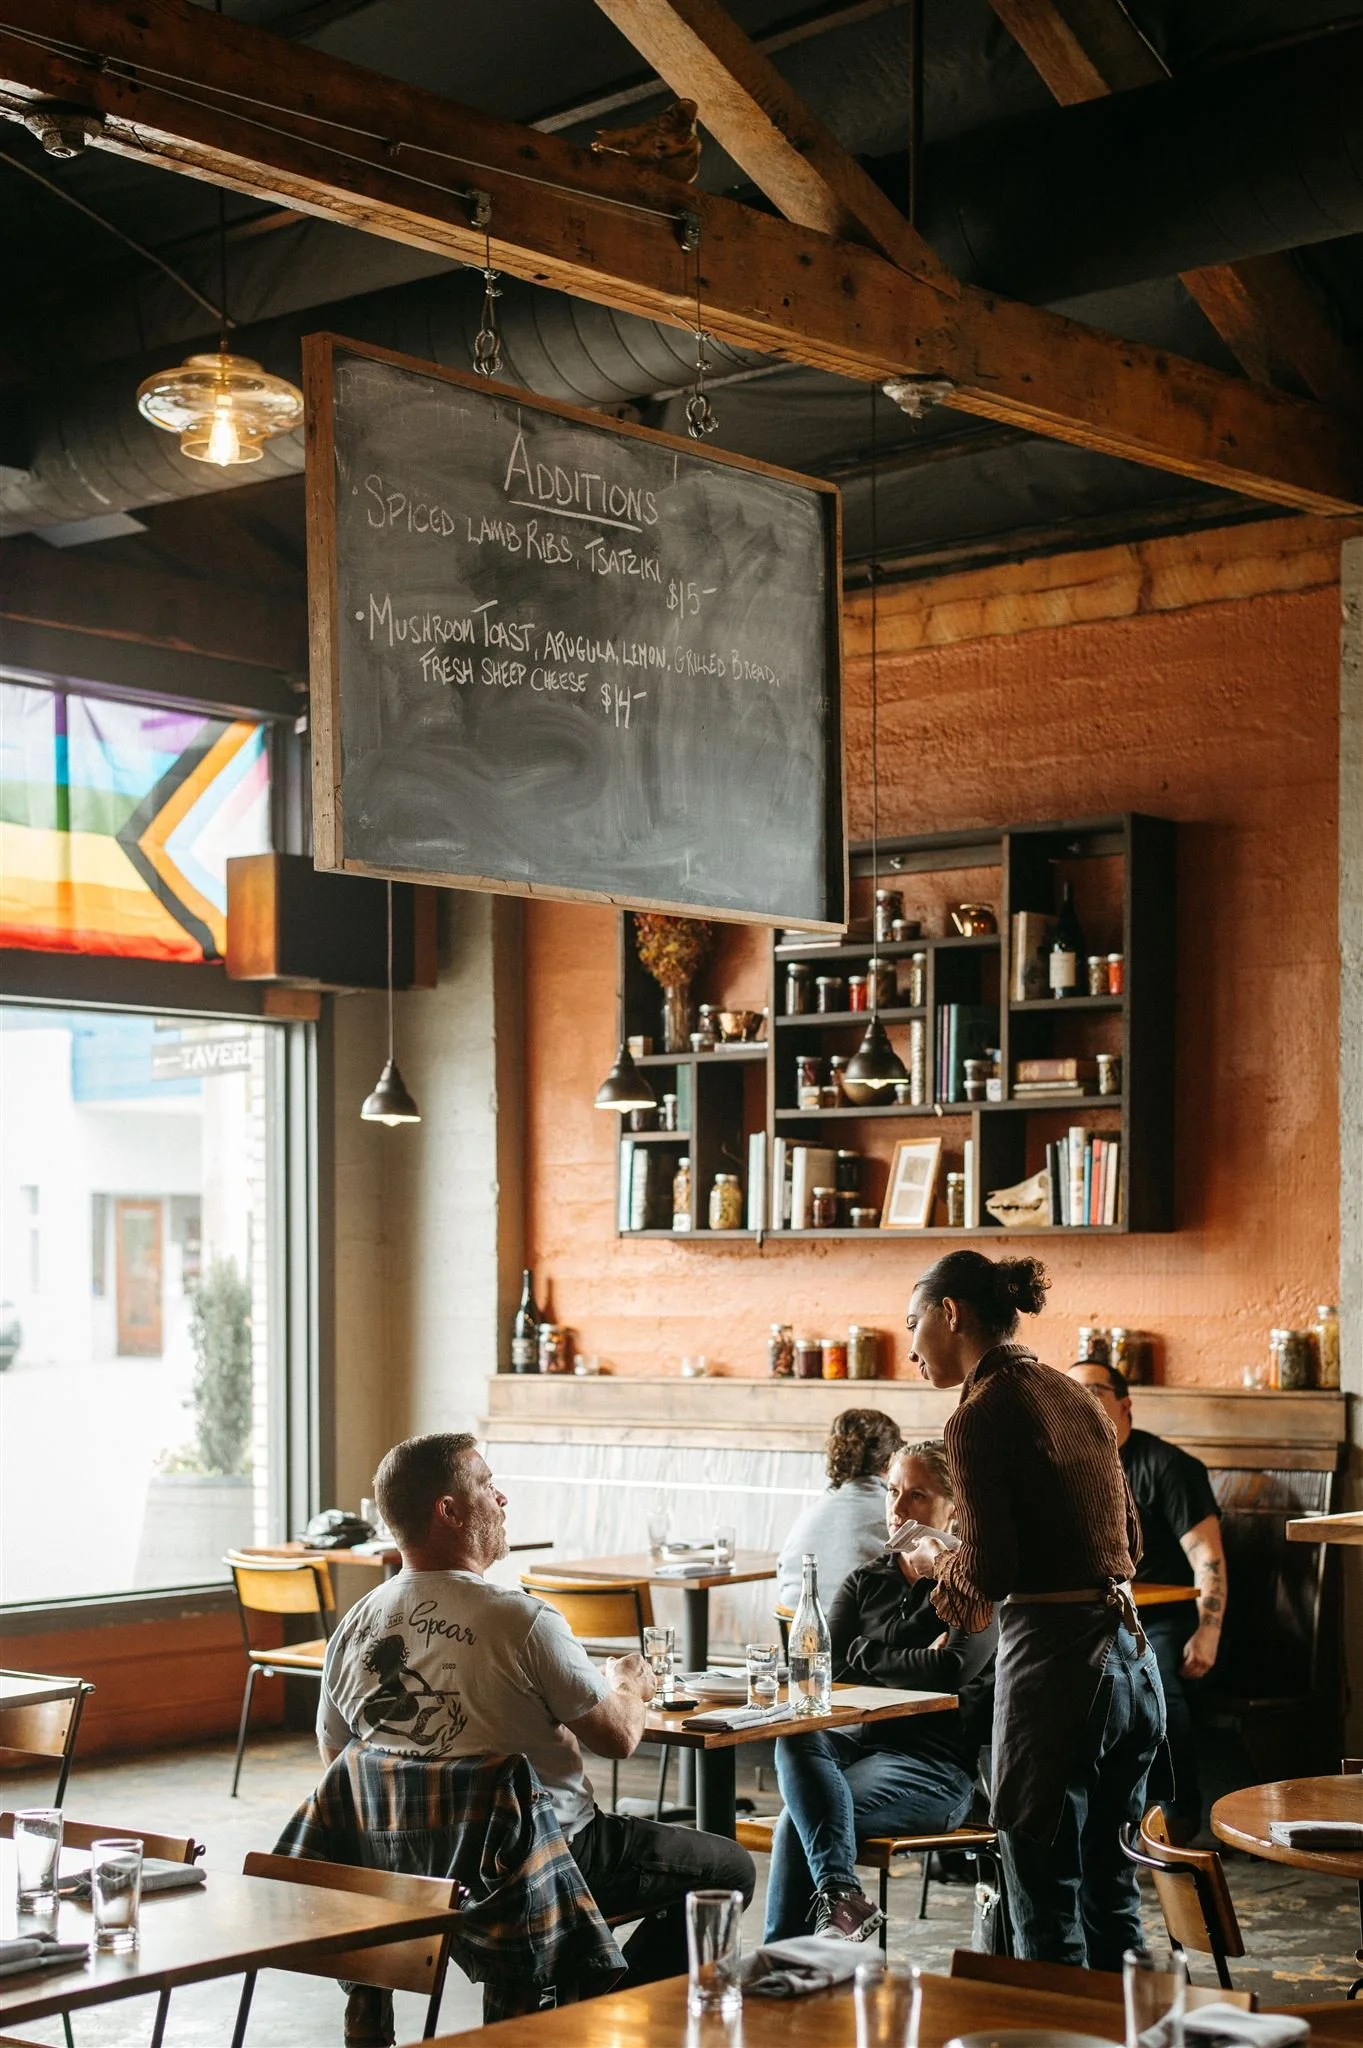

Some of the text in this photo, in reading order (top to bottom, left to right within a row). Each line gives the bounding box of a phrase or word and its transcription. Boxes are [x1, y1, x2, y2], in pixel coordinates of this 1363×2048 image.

[504, 432, 658, 525] ADDITIONS
[364, 474, 662, 584] SPICED LAMB RIBS, TSATZIKI
[369, 593, 475, 647] MUSHROOM
[471, 599, 538, 660] TOAST,
[544, 630, 619, 667] ARUGULA,
[674, 646, 726, 678] GRILLED
[731, 649, 780, 688] BREAD,
[419, 647, 474, 684] FRESH
[481, 657, 526, 688] SHEEP
[530, 667, 589, 692] CHEESE
[408, 1600, 477, 1649] Spear
